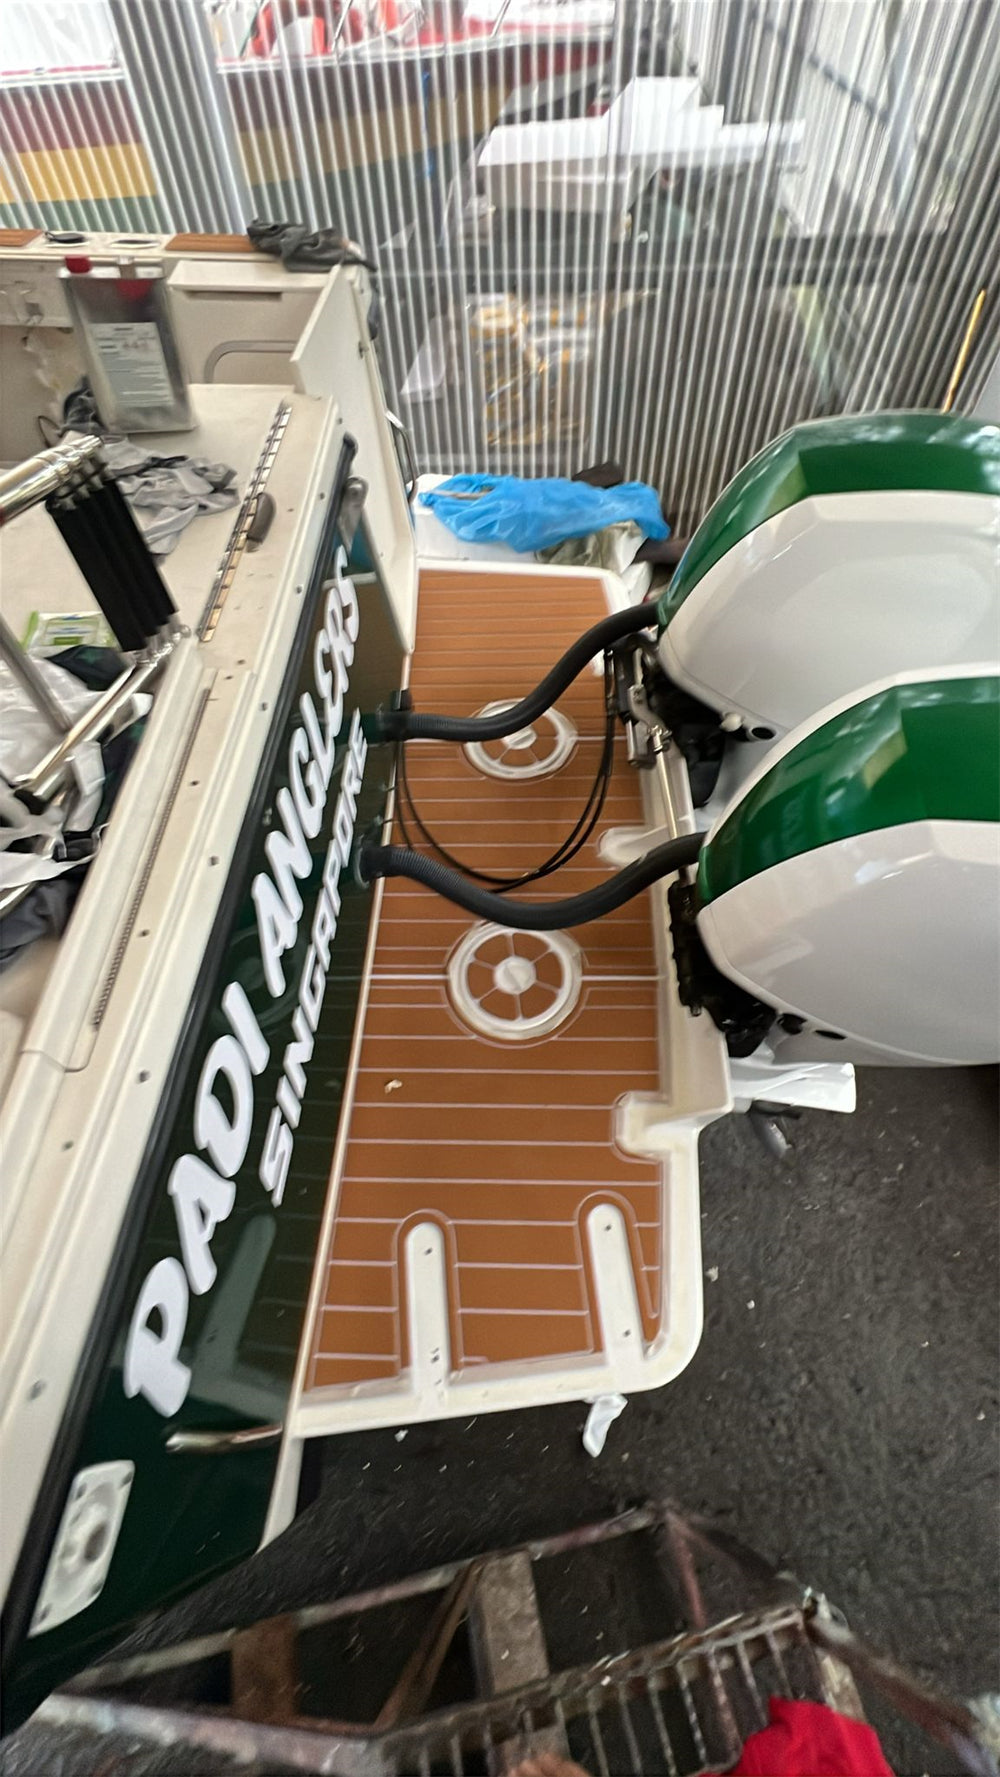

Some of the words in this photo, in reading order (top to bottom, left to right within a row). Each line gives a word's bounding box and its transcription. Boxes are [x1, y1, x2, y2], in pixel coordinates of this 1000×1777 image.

[123, 981, 270, 1418] PADI
[251, 545, 360, 998] ANGLERS
[259, 707, 368, 1208] SINGAPORE
